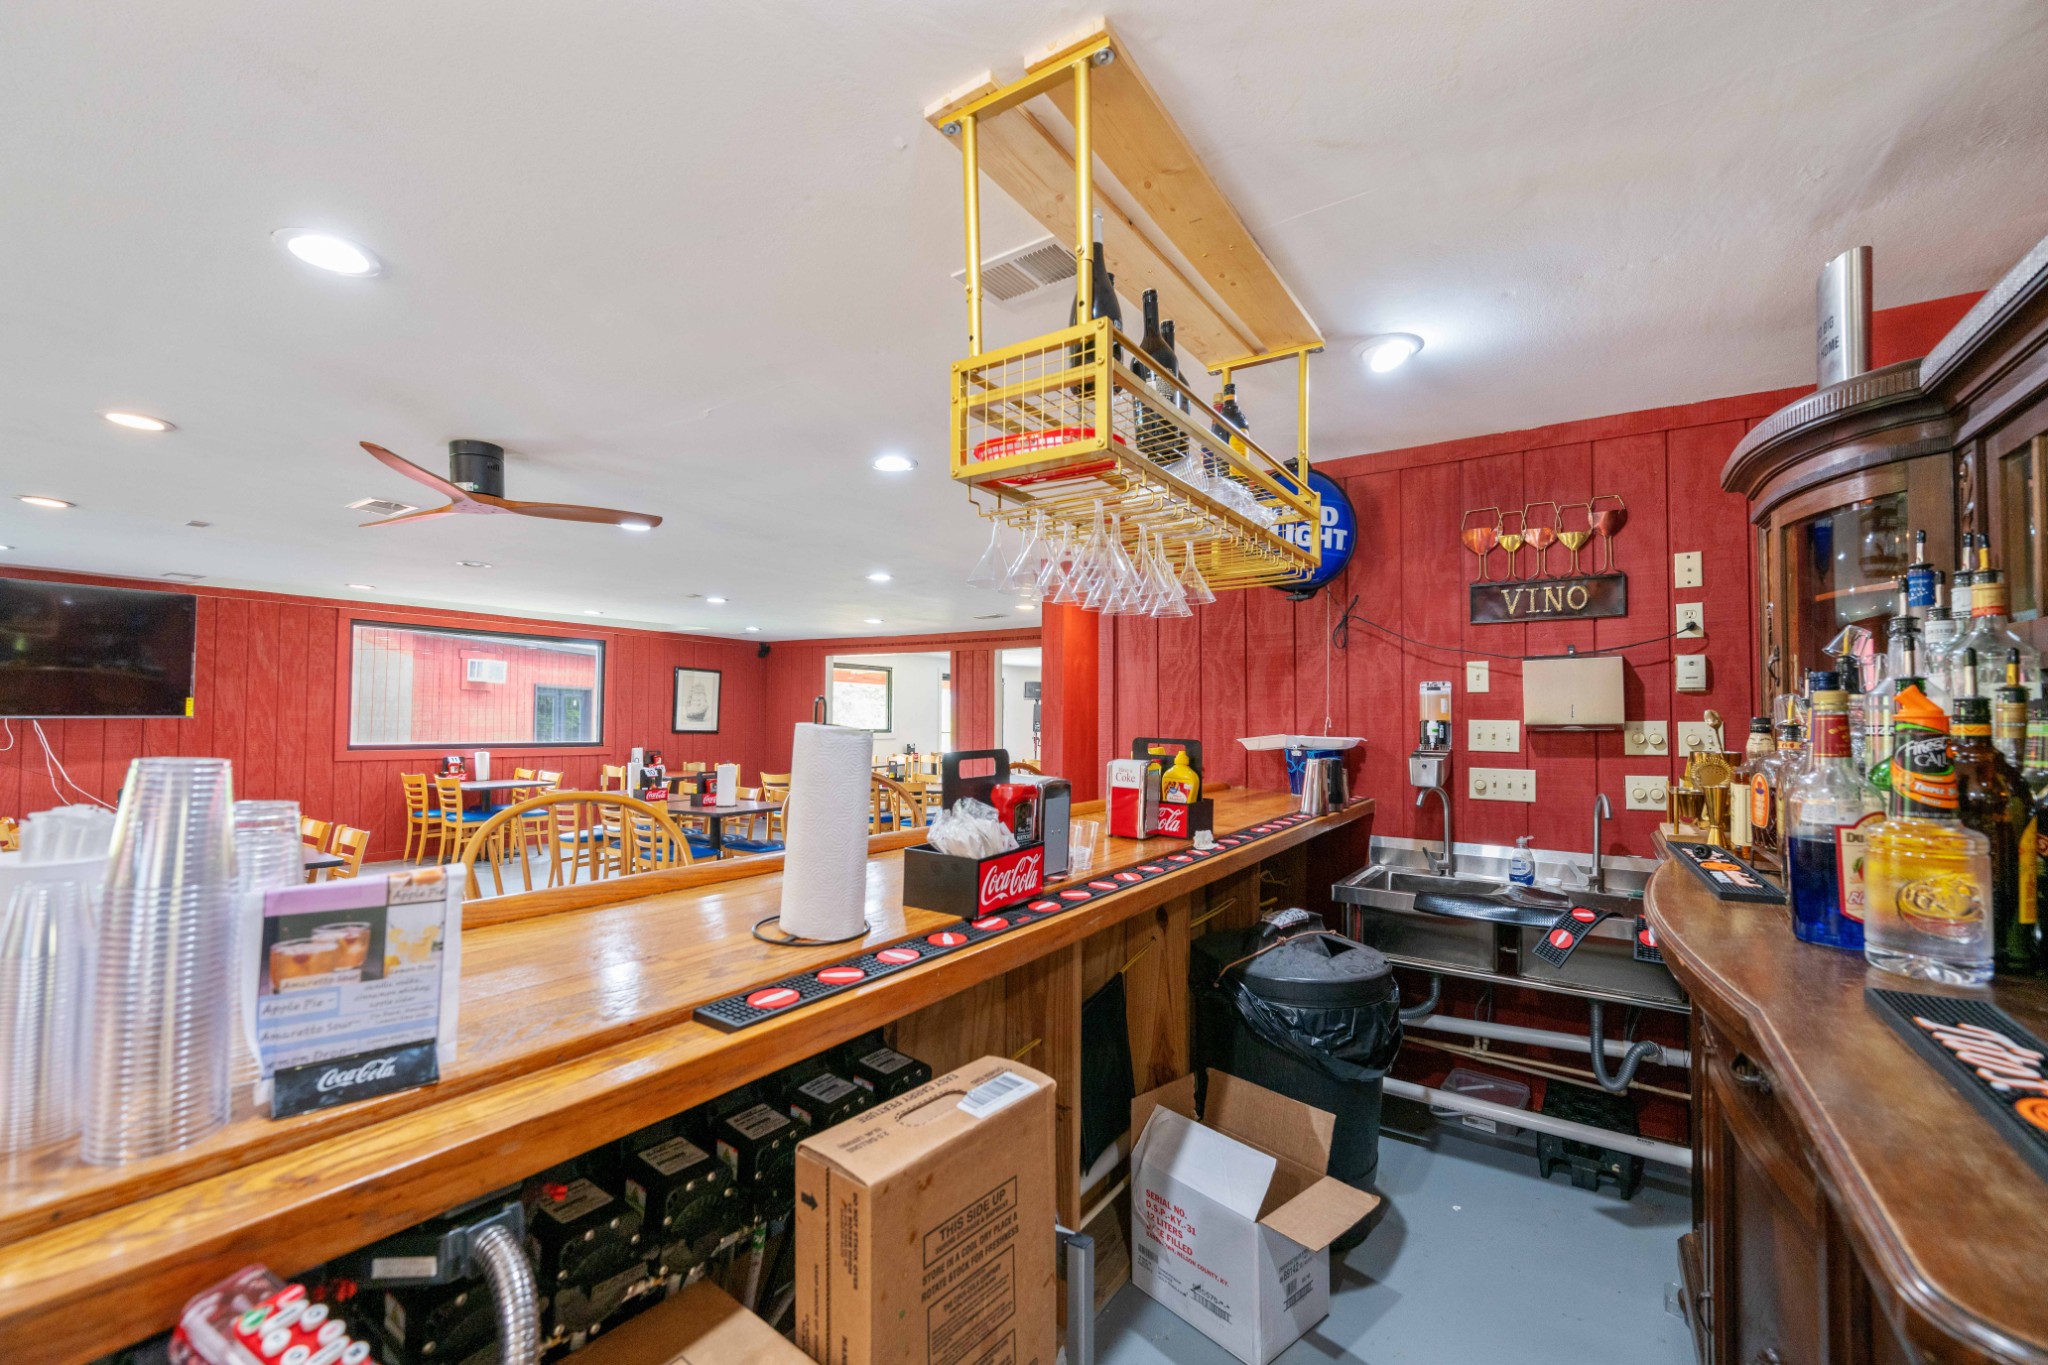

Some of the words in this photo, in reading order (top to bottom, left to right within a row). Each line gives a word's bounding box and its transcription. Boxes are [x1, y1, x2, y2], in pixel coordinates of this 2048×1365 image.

[1820, 335, 1839, 359] HOME
[1268, 524, 1348, 551] IGHT
[1501, 585, 1588, 615] VINO
[1914, 752, 1949, 767] CALL
[1115, 772, 1136, 783] Coke
[1846, 832, 1864, 843] Du
[980, 853, 1041, 906] Coca-Cola
[393, 888, 425, 901] Apple
[427, 886, 445, 898] Pie
[262, 1001, 300, 1017] Apple
[304, 999, 324, 1009] Pie
[261, 1024, 324, 1042] Amaretto
[316, 1055, 399, 1093] Coca-Cola
[939, 1217, 964, 1241] THIS
[966, 1199, 990, 1222] SIDE
[992, 1188, 1006, 1206] UP
[1145, 1188, 1172, 1211] SERIAL
[1173, 1205, 1188, 1220] NO.
[1146, 1211, 1155, 1222] 12
[1156, 1217, 1183, 1239] LITERS
[922, 1262, 945, 1287] STORE
[961, 1241, 978, 1258] COOL
[979, 1229, 992, 1245] DRY
[993, 1217, 1012, 1236] PLACE
[1166, 1234, 1193, 1257] FILLED
[921, 1277, 947, 1302] ROTATE
[948, 1263, 970, 1283] STOCK
[971, 1250, 984, 1267] FOR
